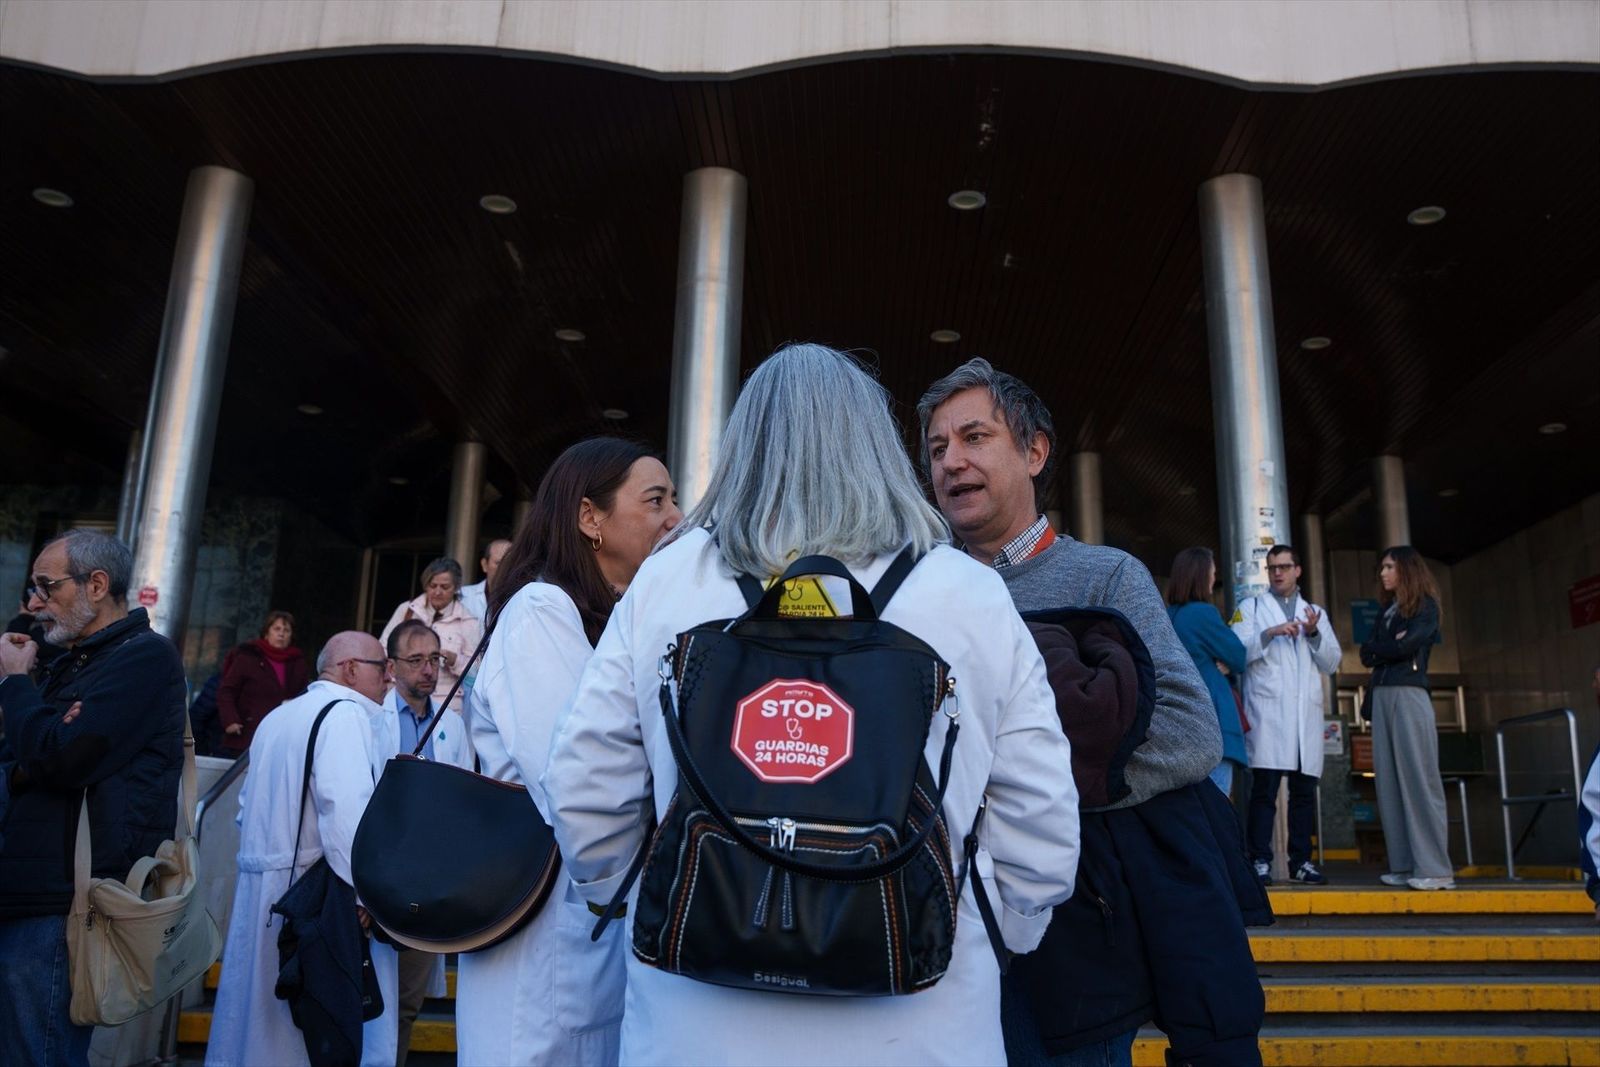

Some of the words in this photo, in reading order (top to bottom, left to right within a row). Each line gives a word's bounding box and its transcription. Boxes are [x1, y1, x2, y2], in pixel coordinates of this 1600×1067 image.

[761, 699, 833, 720] STOP
[755, 740, 829, 756] GUARDIAS
[755, 752, 772, 763] 24
[776, 752, 826, 767] HORAS
